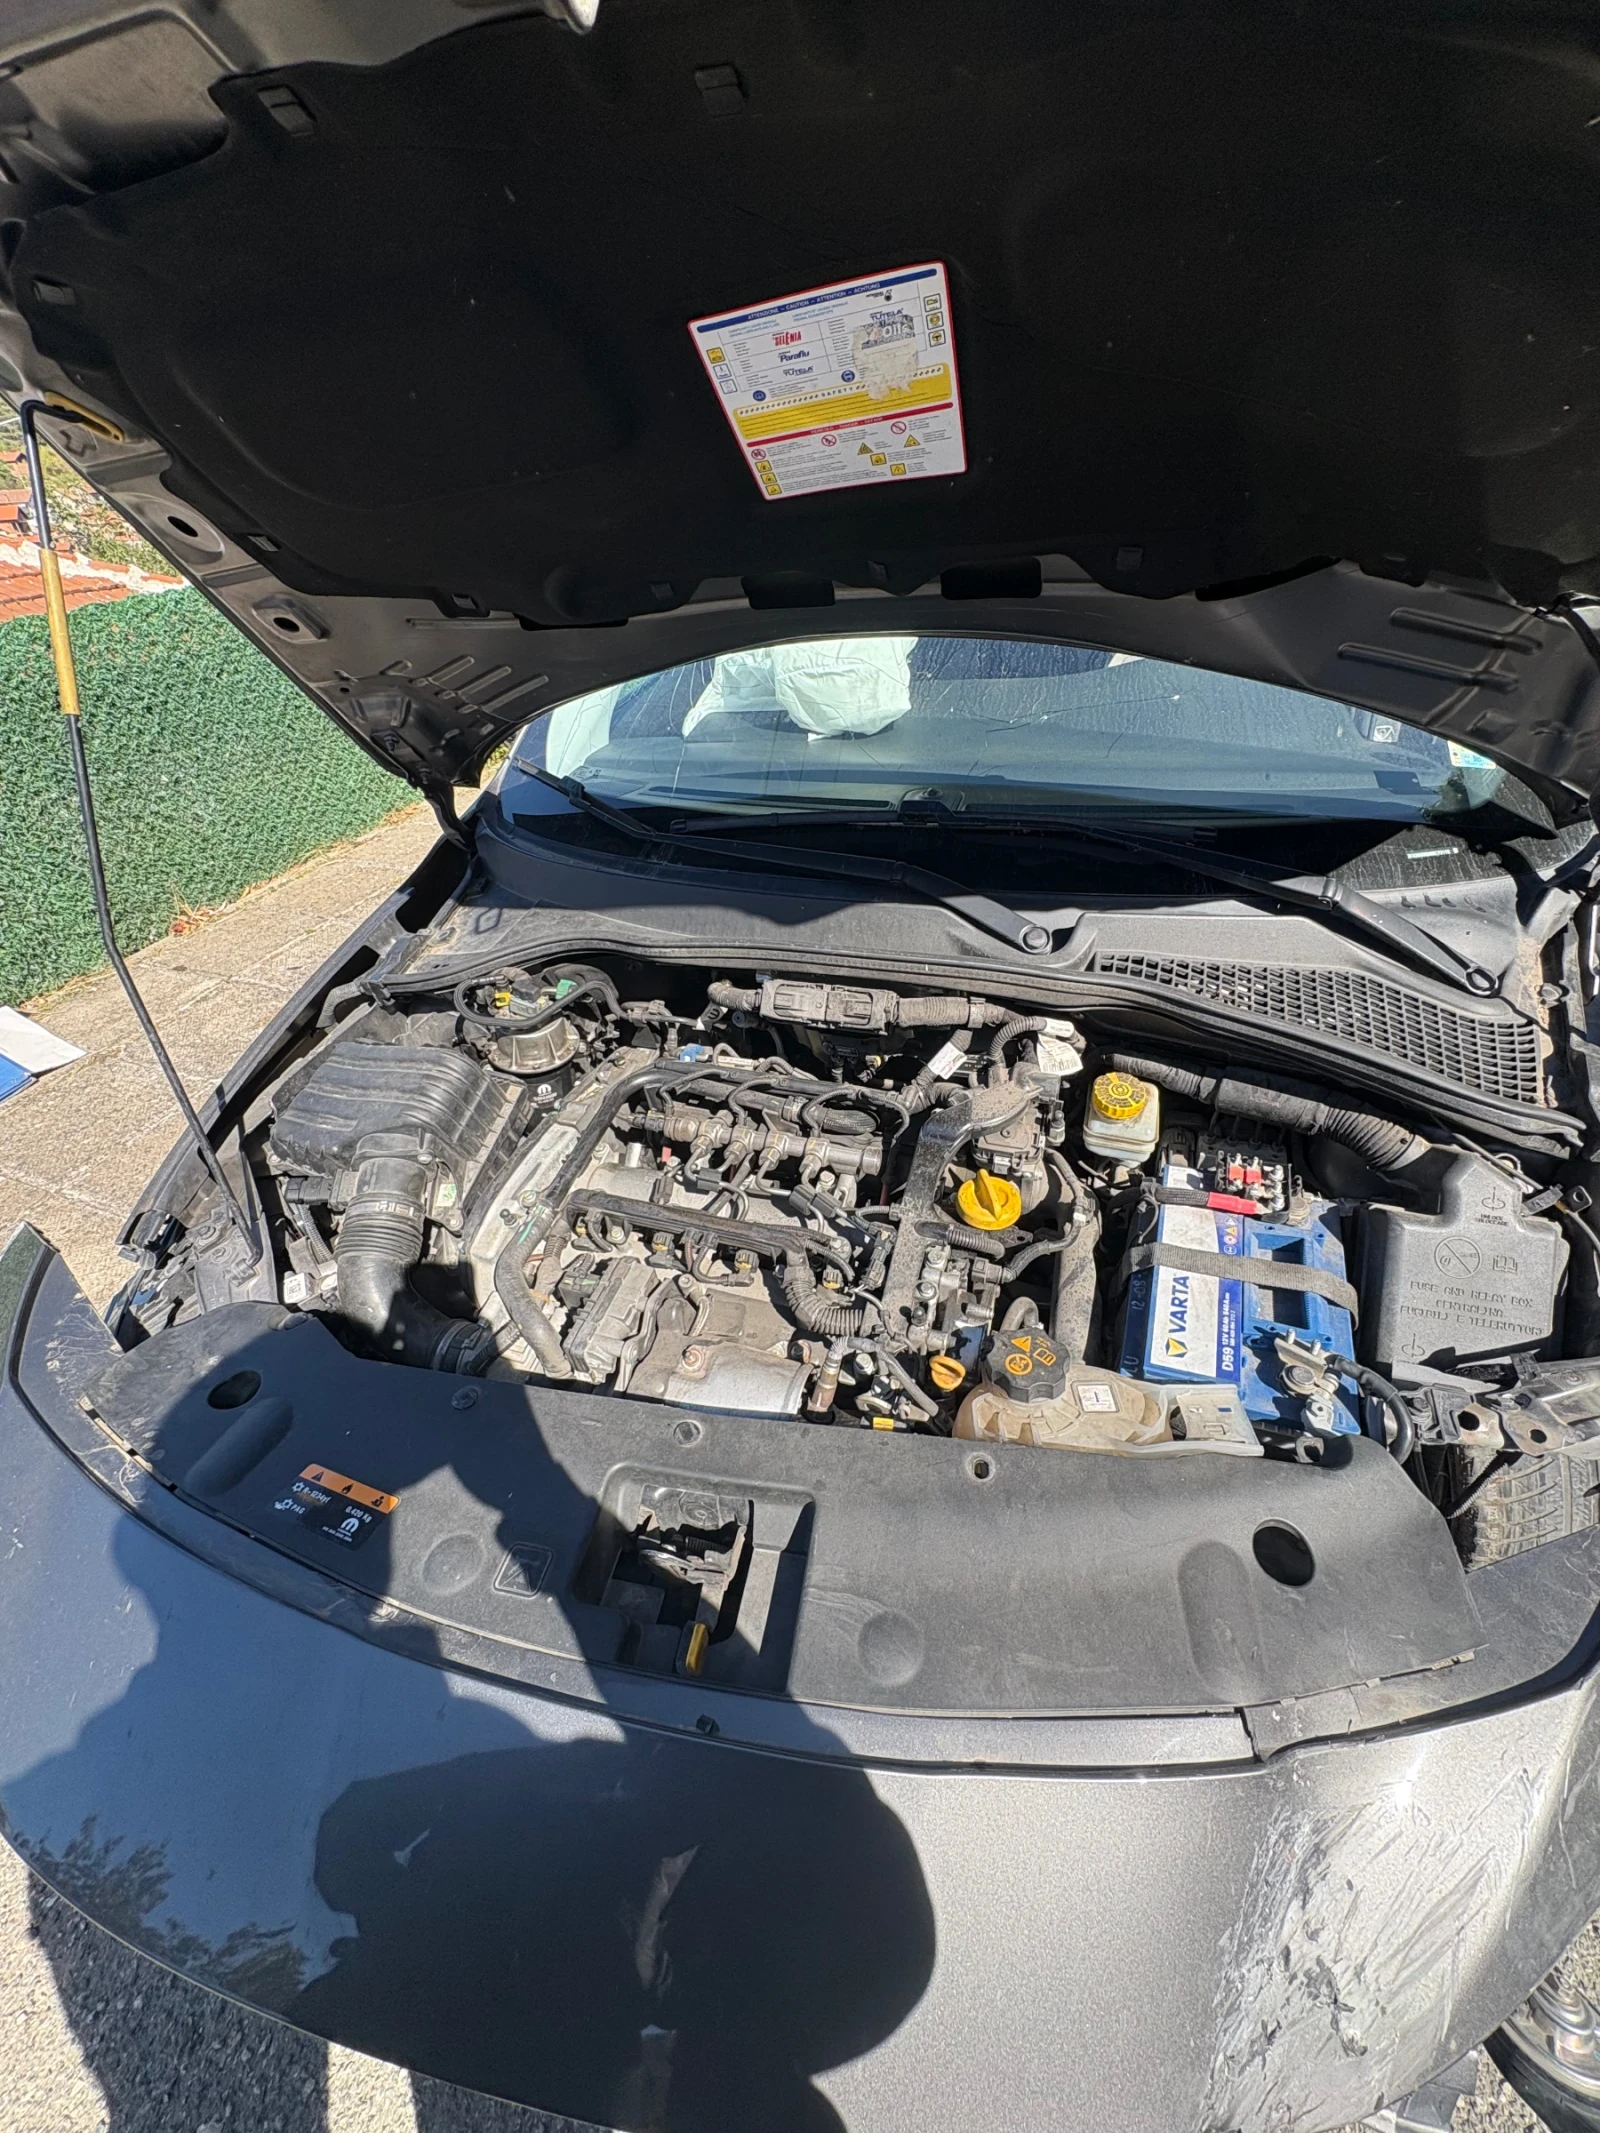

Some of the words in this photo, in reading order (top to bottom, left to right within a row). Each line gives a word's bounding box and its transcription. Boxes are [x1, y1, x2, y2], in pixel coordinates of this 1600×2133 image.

[747, 307, 780, 320] ATTENZIONE
[785, 300, 810, 311] CAUTION
[816, 291, 846, 302] ATTENTION
[853, 282, 881, 294] ACHTUNG
[870, 310, 903, 322] TUTELA
[779, 350, 810, 363] Paraflu
[783, 366, 814, 377] TUTELA
[821, 386, 854, 398] SAFETY
[1410, 1280, 1440, 1292] FUSE
[1444, 1286, 1465, 1297] AND
[1471, 1290, 1507, 1304] RELAY
[1511, 1296, 1534, 1308] BOX
[1168, 1274, 1190, 1335] VARTA
[1436, 1299, 1504, 1318] CENTRALINA
[1400, 1305, 1449, 1321] FUSIBILI
[1456, 1315, 1466, 1323] E
[1221, 1347, 1235, 1372] D59
[290, 1503, 307, 1515] PAG
[361, 1512, 373, 1524] Kg
